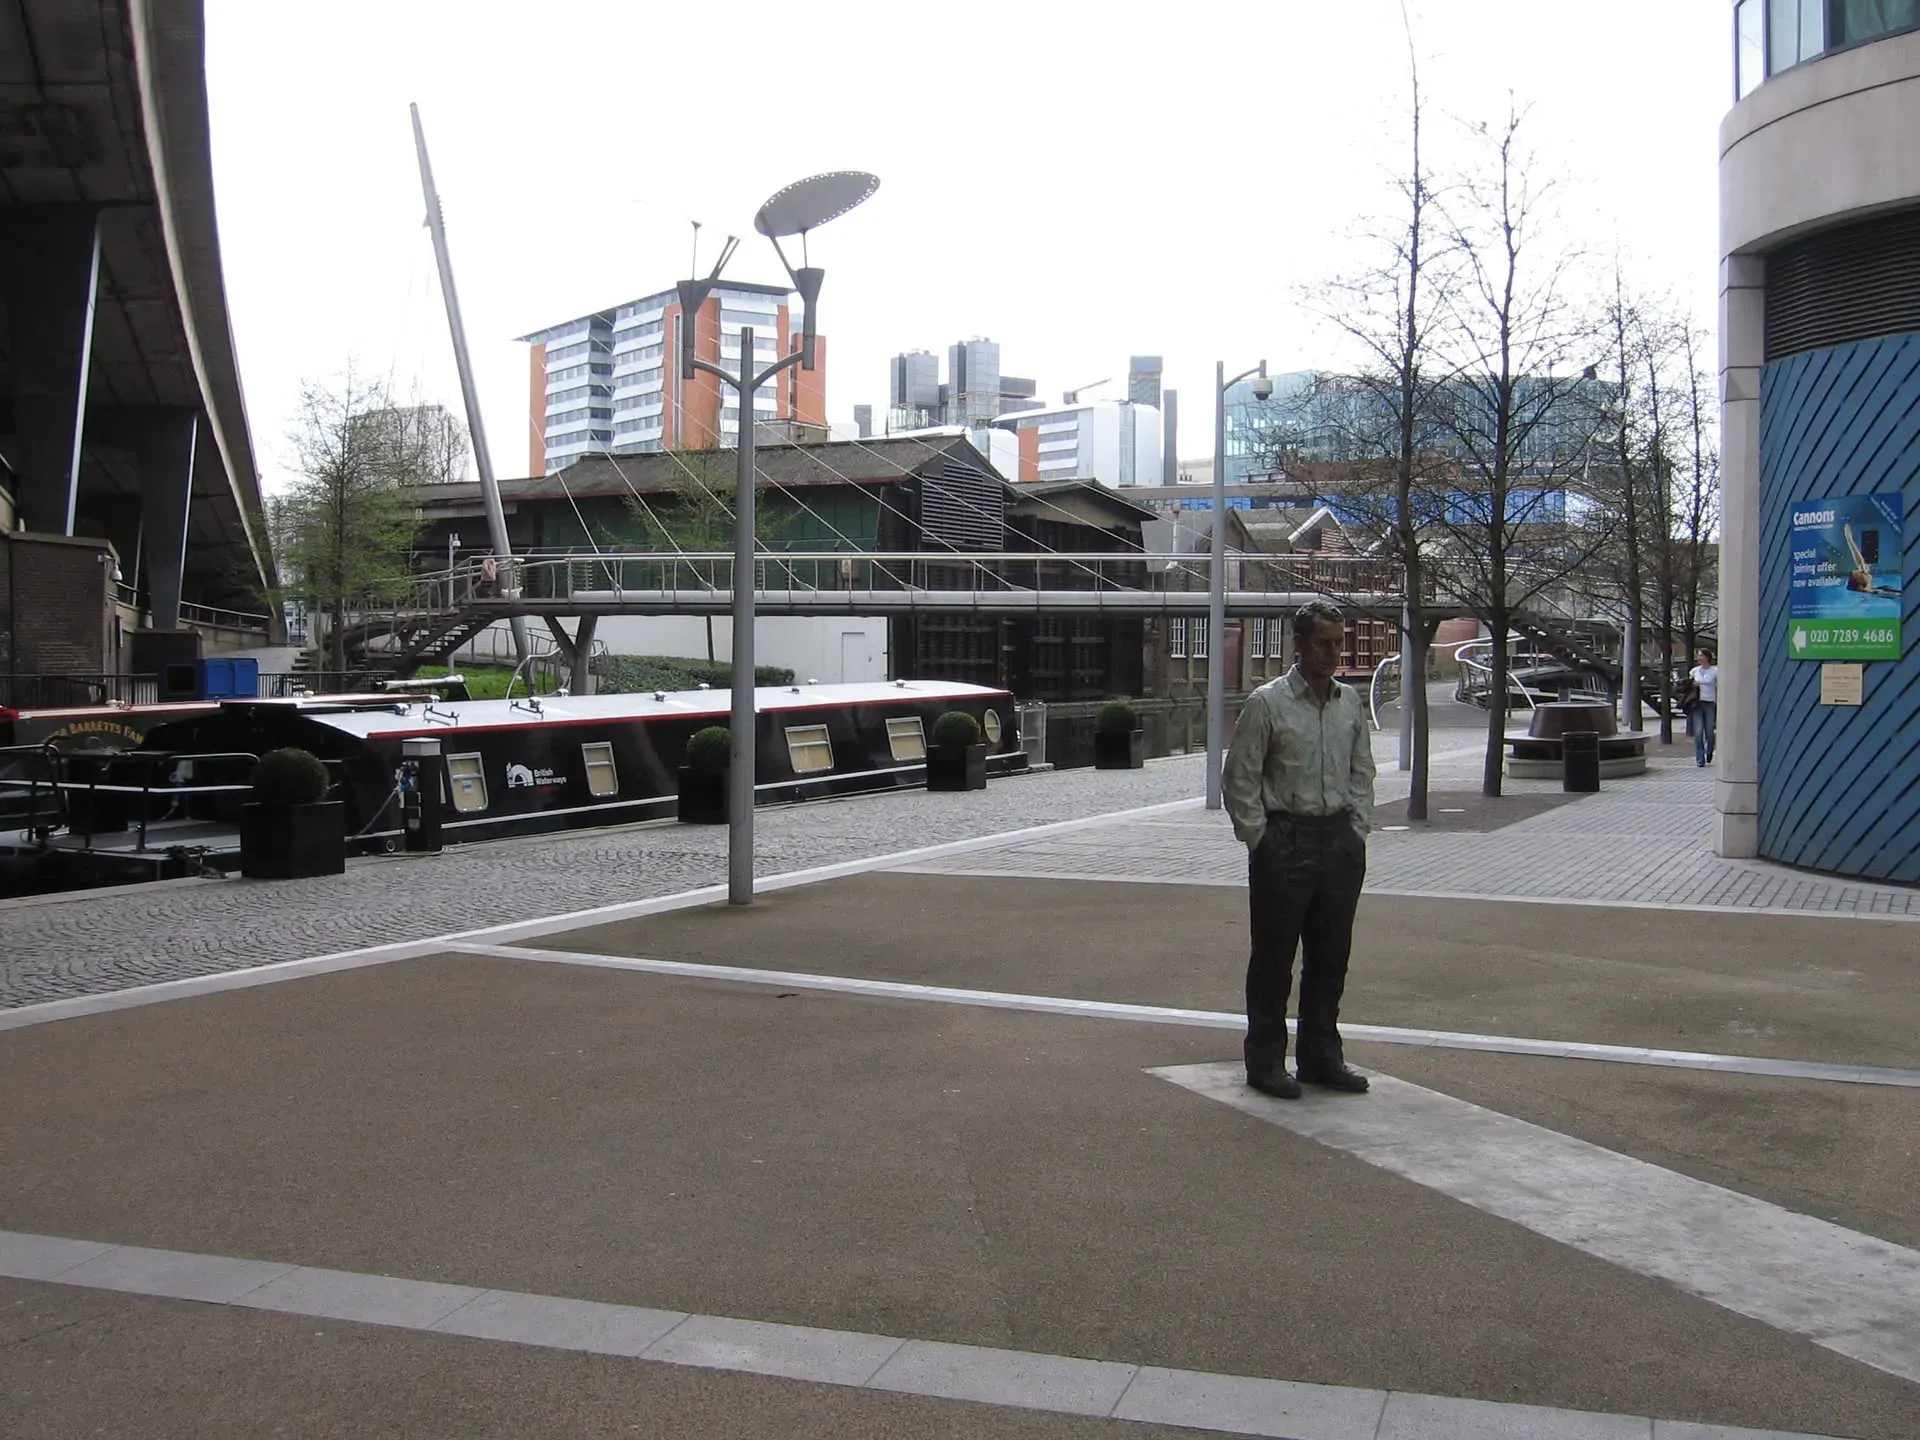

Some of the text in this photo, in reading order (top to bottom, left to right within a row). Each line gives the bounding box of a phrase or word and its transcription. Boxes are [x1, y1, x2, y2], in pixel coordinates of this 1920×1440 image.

[1793, 510, 1835, 526] Cannons
[1793, 548, 1816, 561] special
[1793, 561, 1836, 576] joining offer
[1793, 576, 1841, 588] now available
[1810, 629, 1894, 643] 020 7289 4686
[68, 720, 122, 735] BARRETTS
[533, 768, 554, 777] British
[535, 776, 567, 785] Waterways
